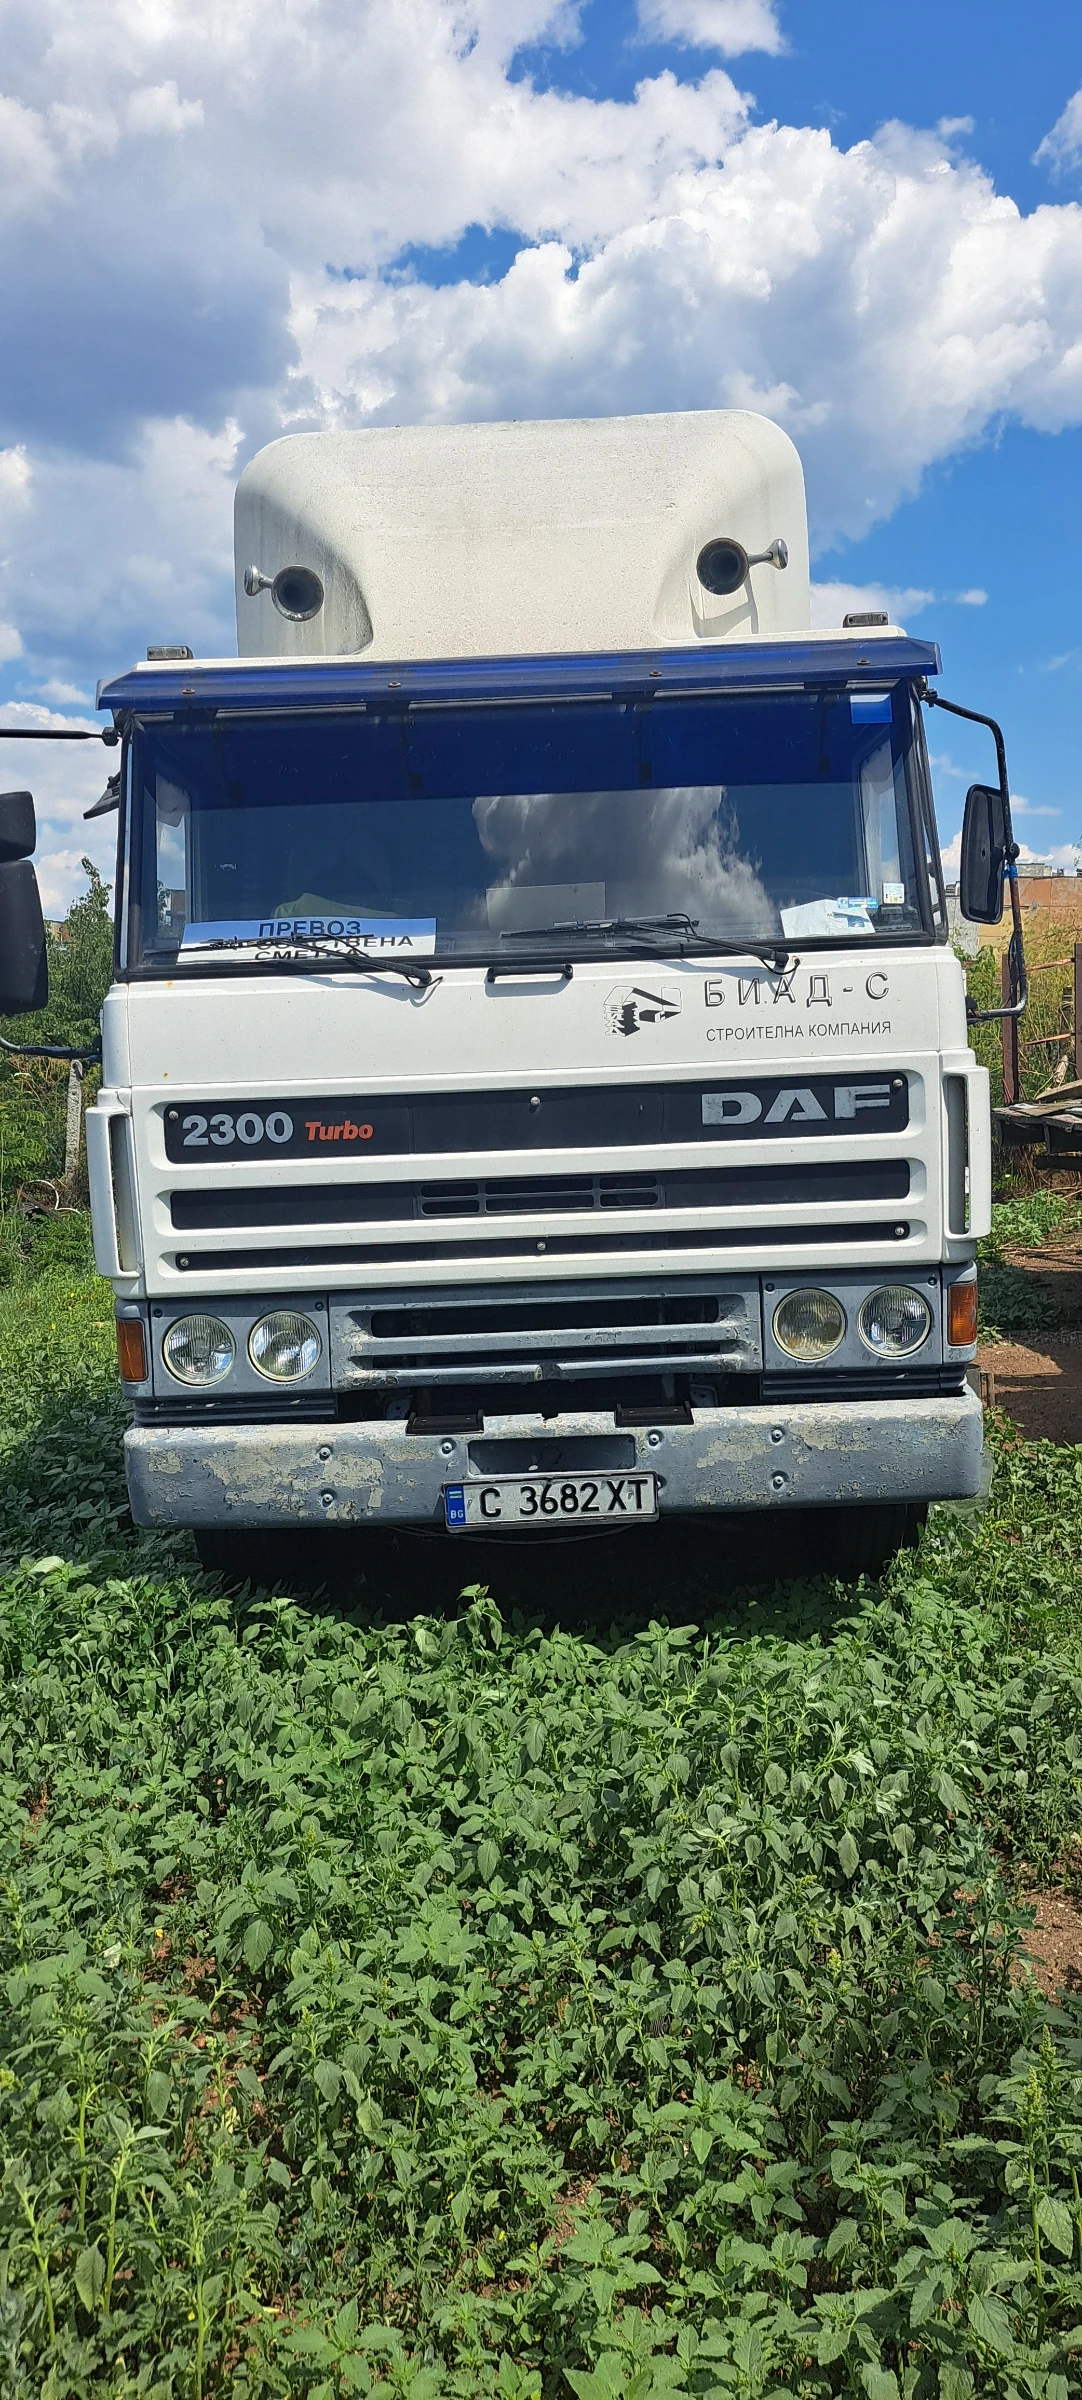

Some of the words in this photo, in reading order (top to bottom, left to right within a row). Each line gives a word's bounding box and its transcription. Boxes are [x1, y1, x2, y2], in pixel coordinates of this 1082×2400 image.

[258, 920, 362, 937] ПРЕВОЗ
[706, 1025, 804, 1042] СТРОИТЕЛНА
[808, 1021, 891, 1037] КОМПАНИЯ
[701, 1084, 891, 1127] DAF
[182, 1111, 294, 1147] 2300
[305, 1120, 374, 1142] Turbo
[450, 1510, 464, 1519] BG
